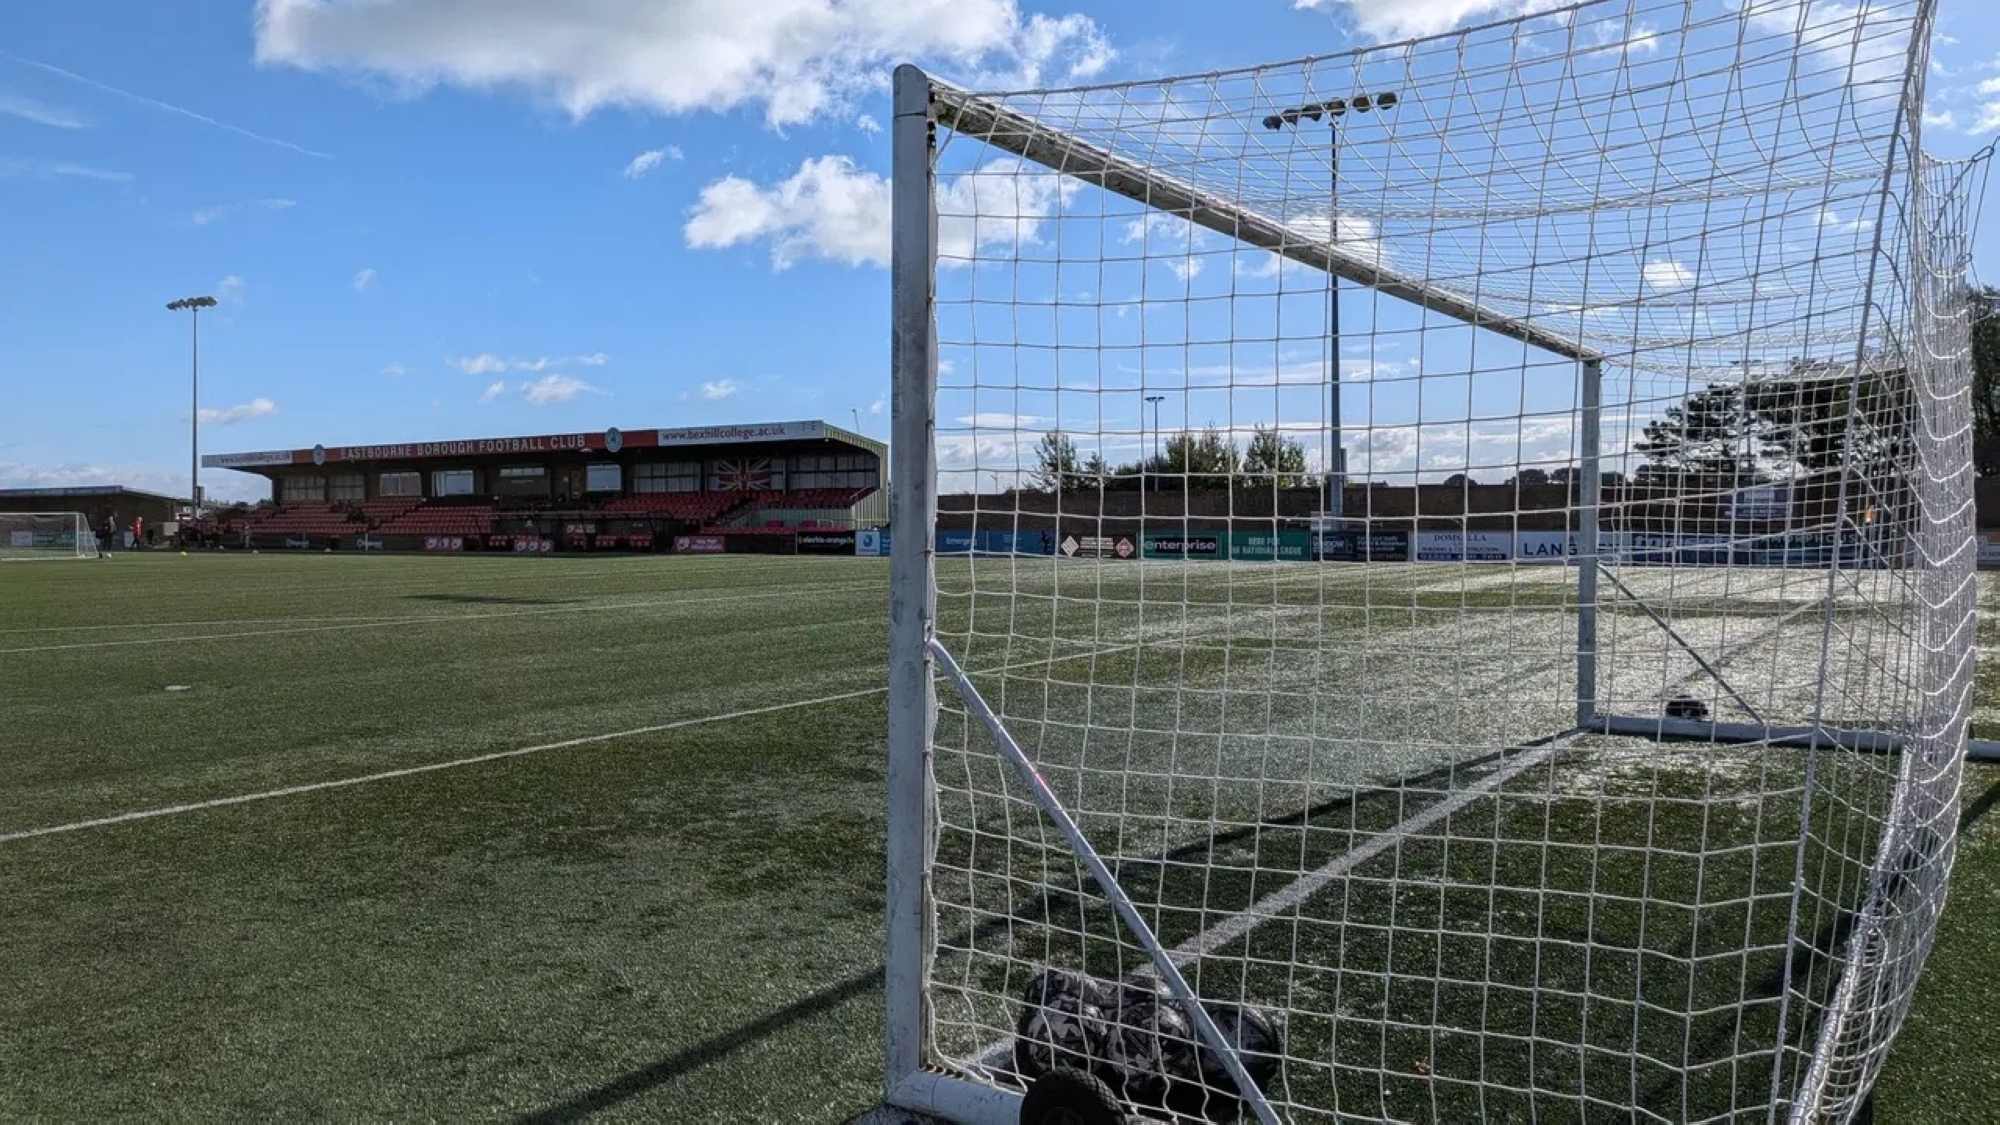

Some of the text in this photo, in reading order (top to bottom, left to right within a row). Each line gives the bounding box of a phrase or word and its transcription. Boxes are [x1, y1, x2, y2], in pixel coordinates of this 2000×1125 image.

[662, 426, 786, 442] www.bexhillcollege.ac.uk
[340, 435, 586, 459] EASTBOURNE BOROUGH FOOTBALL CLUB
[1434, 534, 1487, 542] DOMSLLA
[1145, 539, 1215, 552] enterprise
